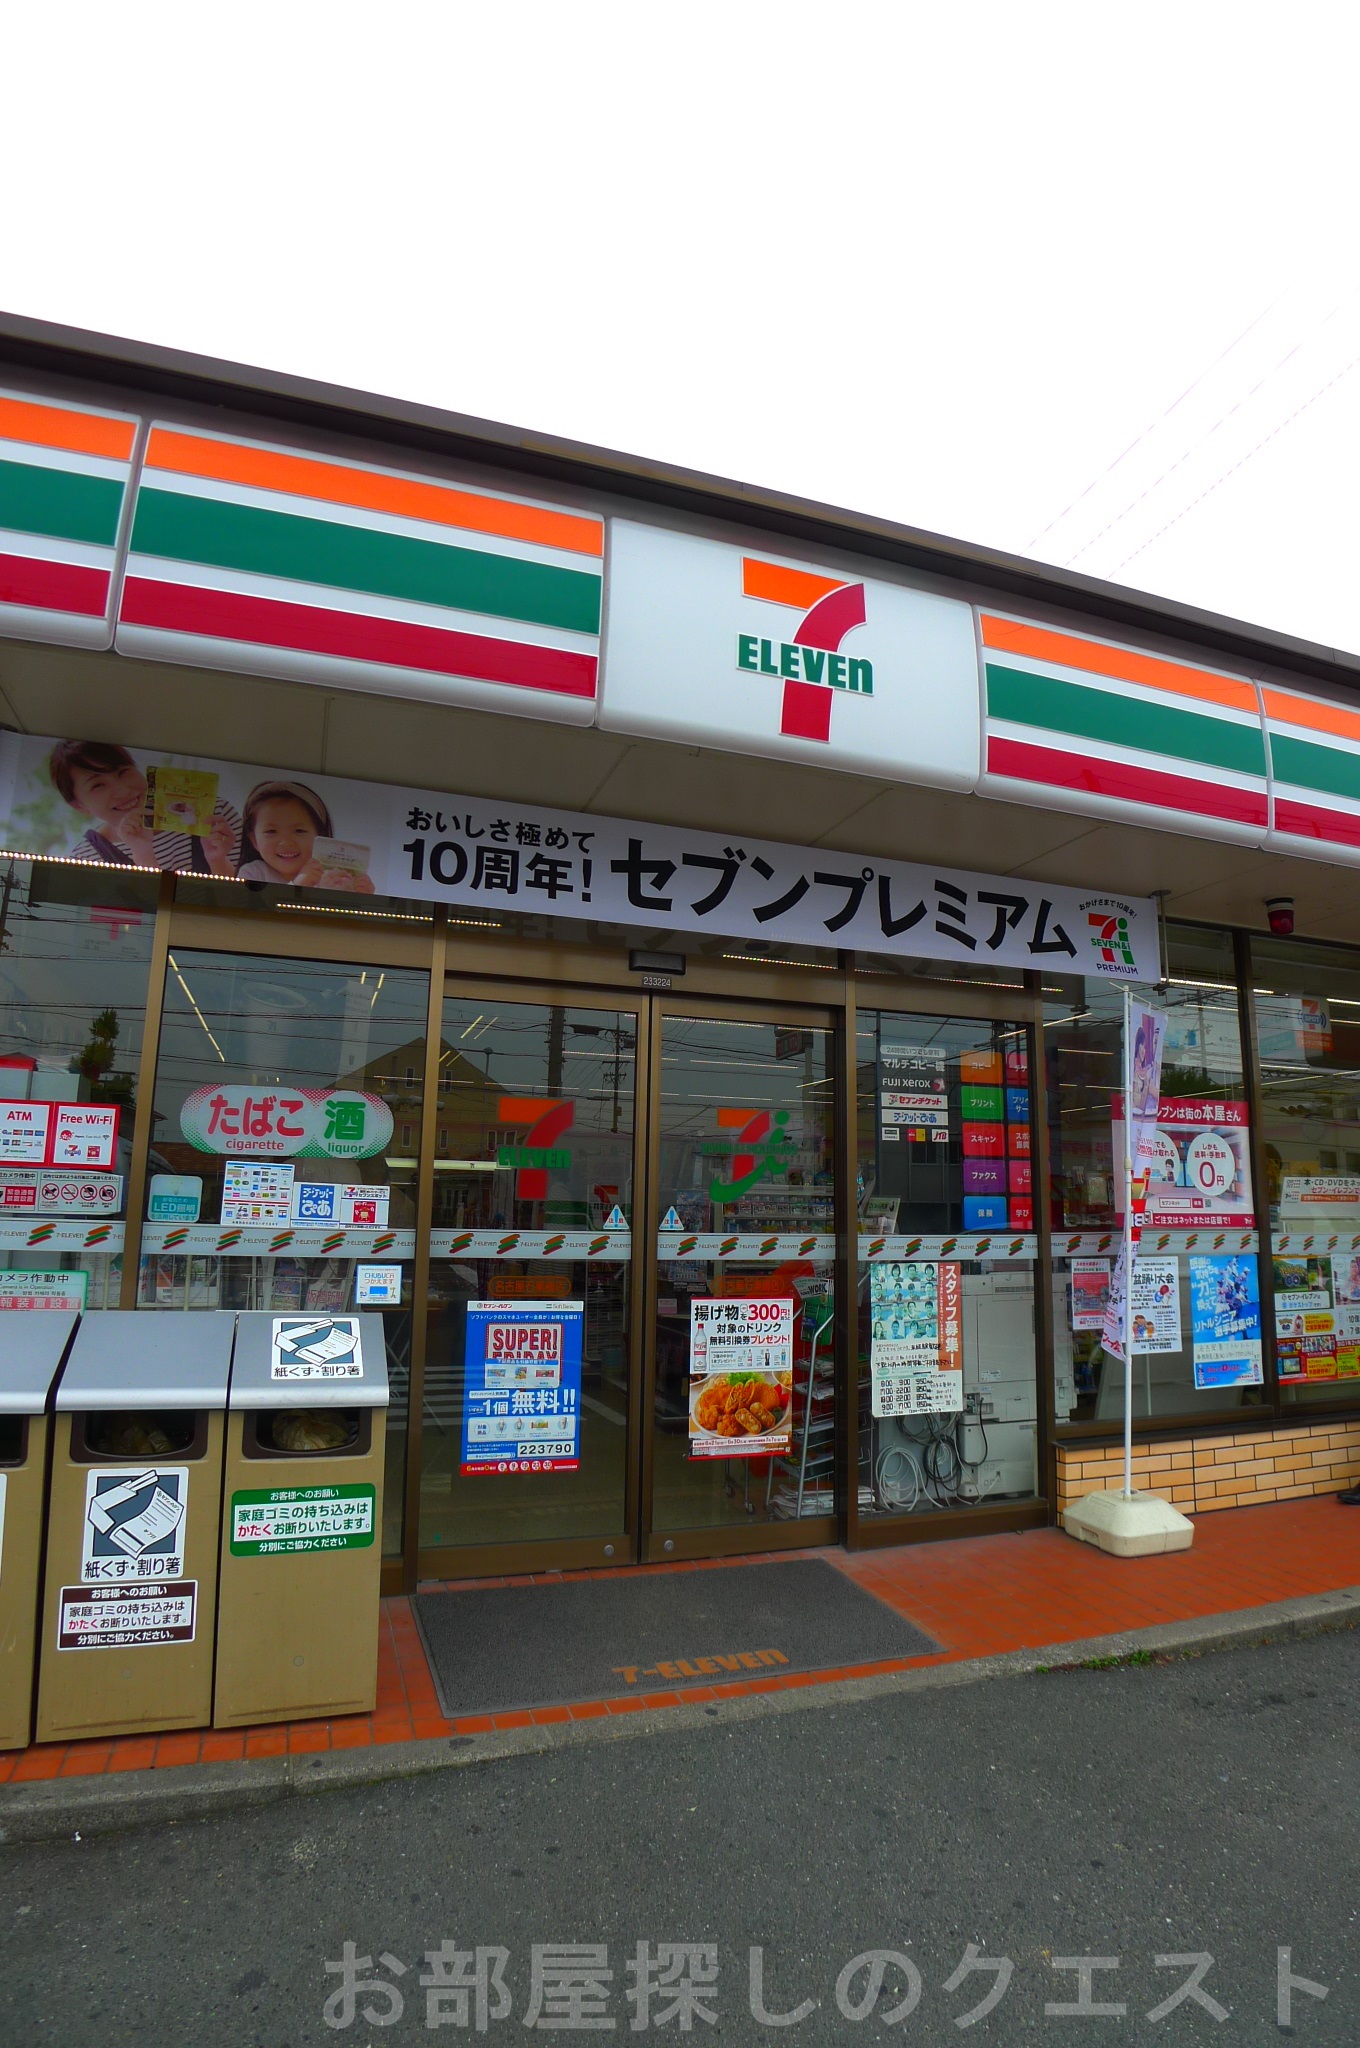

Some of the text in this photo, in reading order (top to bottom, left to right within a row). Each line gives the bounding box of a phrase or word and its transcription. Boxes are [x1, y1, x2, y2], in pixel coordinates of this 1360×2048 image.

[405, 806, 596, 854] おいしさ極めて
[403, 838, 1078, 958] 10周年! セブンプレミアム
[1096, 963, 1139, 976] PREMIUM
[643, 976, 671, 987] 233224
[882, 1058, 946, 1072] マルチコピー機
[972, 1062, 991, 1070] コピー
[882, 1078, 931, 1088] FUJI xerox
[899, 1095, 942, 1106] セブンチケット
[971, 1099, 995, 1107] プリント
[7, 1111, 113, 1126] ATM Free Wi-Fi
[207, 1094, 366, 1141] たばこ 酒
[893, 1112, 937, 1124] チケットぴあ
[971, 1135, 996, 1143] スキャン
[226, 1138, 365, 1155] cigarette liquor
[1202, 1143, 1218, 1151] しかも
[972, 1172, 997, 1180] ファクス
[303, 1187, 333, 1198] チケット
[153, 1202, 196, 1213] LED照明
[301, 1199, 331, 1217] ぴあ
[978, 1209, 993, 1217] 保険
[0, 1273, 69, 1283] メラ作動中
[1132, 1273, 1175, 1285] 盆踊り大会
[1194, 1310, 1237, 1332] リトルシニア
[717, 1322, 782, 1334] 対象のドリンク
[709, 1334, 790, 1346] 無料引換券プレゼント!
[274, 1365, 360, 1378] 紙くず・割り箸
[520, 1443, 572, 1455] 223790
[270, 1489, 339, 1501] お客様へのお願い
[238, 1502, 368, 1522] 家庭ゴミの持ち込みは
[238, 1517, 370, 1537] かたくお断りいたします。
[259, 1537, 347, 1552] 分別にご協力ください
[84, 1557, 181, 1579] 紙くず・割り箸
[91, 1586, 168, 1599] お客様へのお願い
[69, 1601, 185, 1618] 家庭ゴミの持ち込みは
[68, 1613, 187, 1630] かたくお断りいたします。
[77, 1630, 174, 1645] 分別にご協力ください。
